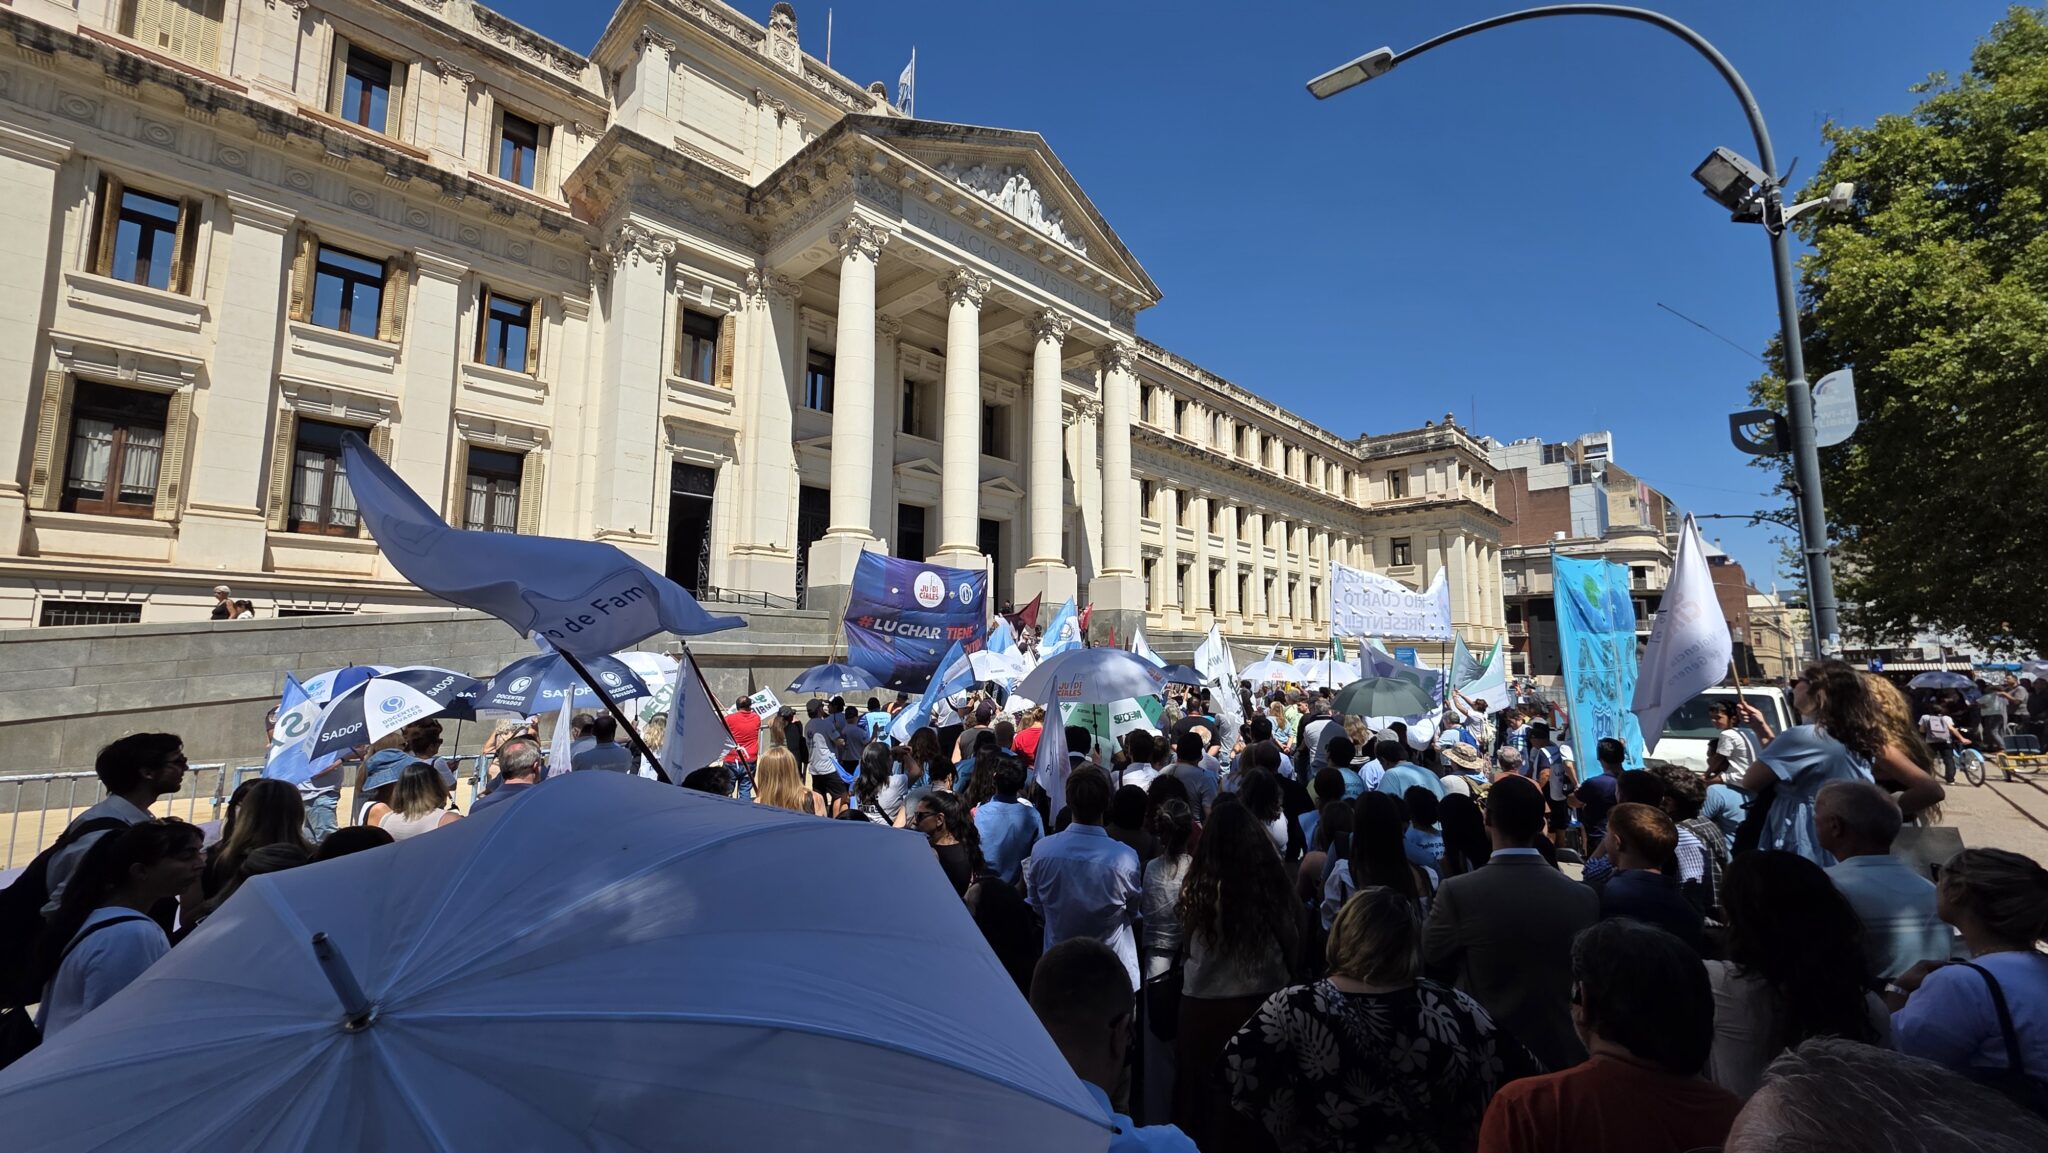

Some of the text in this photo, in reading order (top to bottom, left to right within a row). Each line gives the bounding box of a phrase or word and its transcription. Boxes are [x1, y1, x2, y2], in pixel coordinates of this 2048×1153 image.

[916, 208, 1000, 264] PALACIO
[1007, 260, 1023, 276] DE
[564, 614, 596, 633] de
[426, 675, 455, 697] SADOP
[492, 698, 523, 706] PRIVADOS
[495, 693, 526, 701] DOCENTES
[382, 704, 420, 725] DOCENTES
[385, 709, 423, 729] PRIVADOS
[321, 722, 363, 742] SADOP
